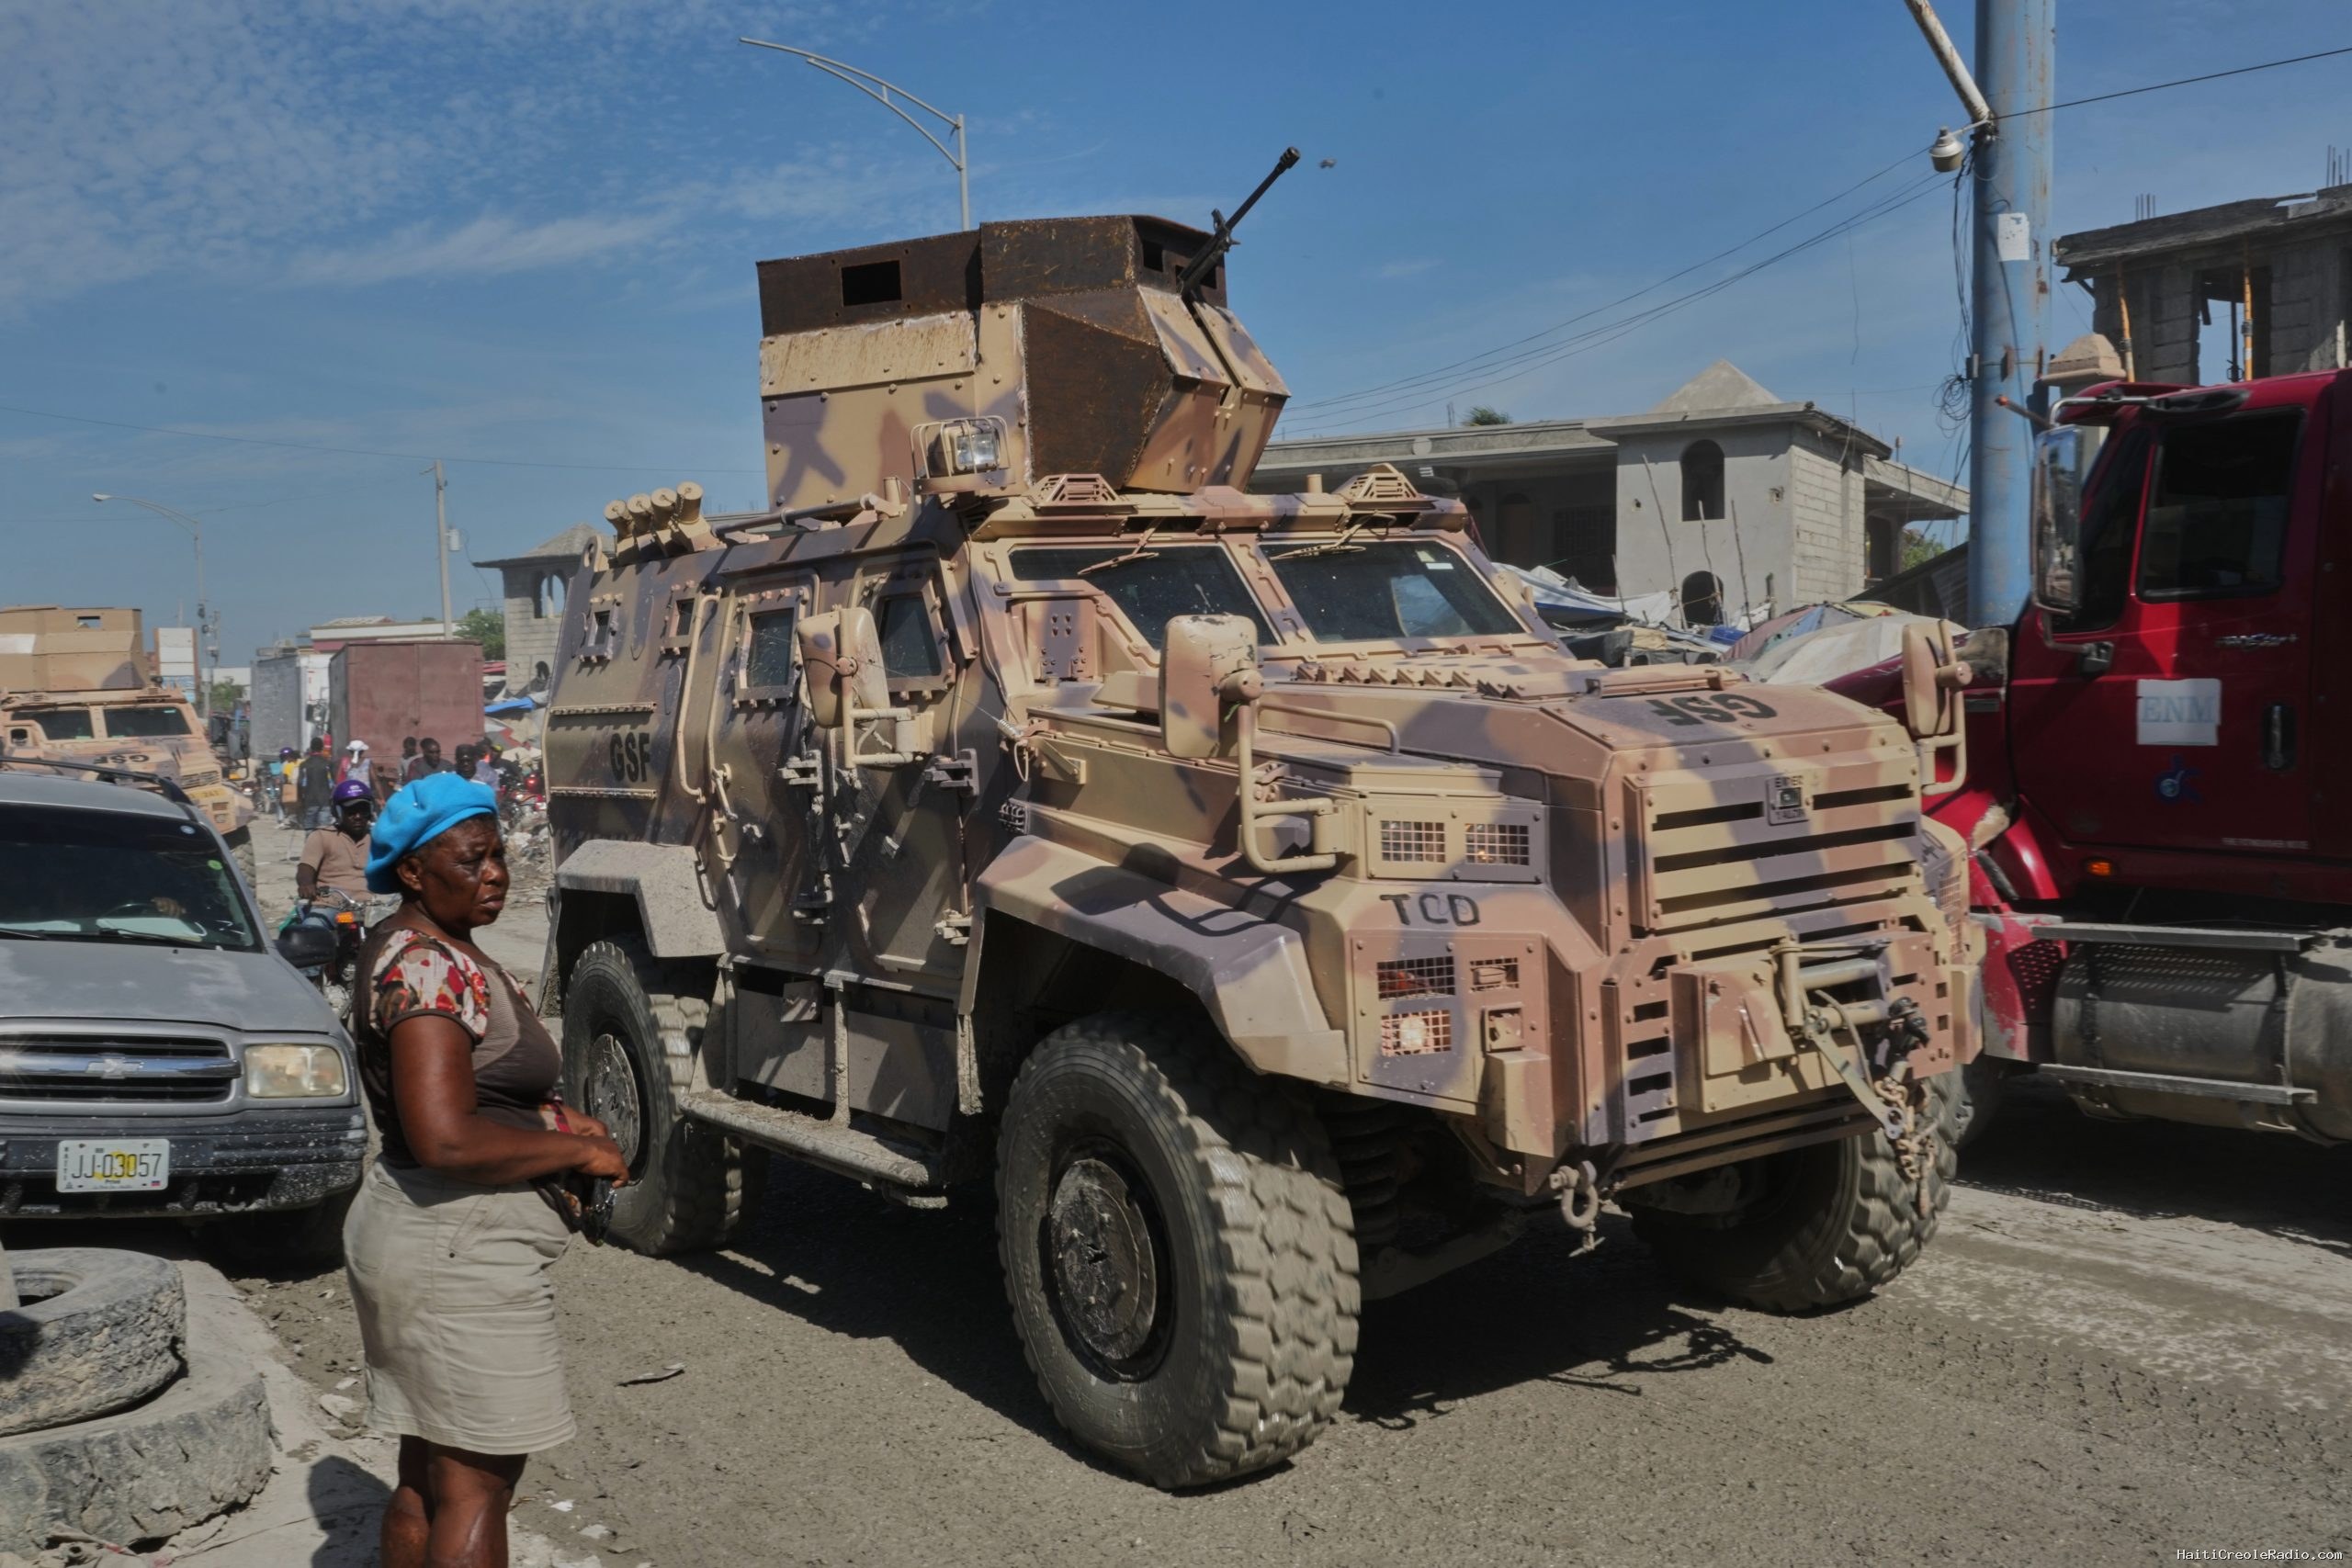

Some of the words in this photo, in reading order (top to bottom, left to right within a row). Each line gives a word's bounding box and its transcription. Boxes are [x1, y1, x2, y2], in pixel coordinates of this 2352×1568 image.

[1645, 694, 1778, 726] GSF
[2142, 695, 2216, 723] ENM
[93, 754, 150, 765] GSF
[610, 732, 650, 783] GSF
[1379, 894, 1481, 927] TCD
